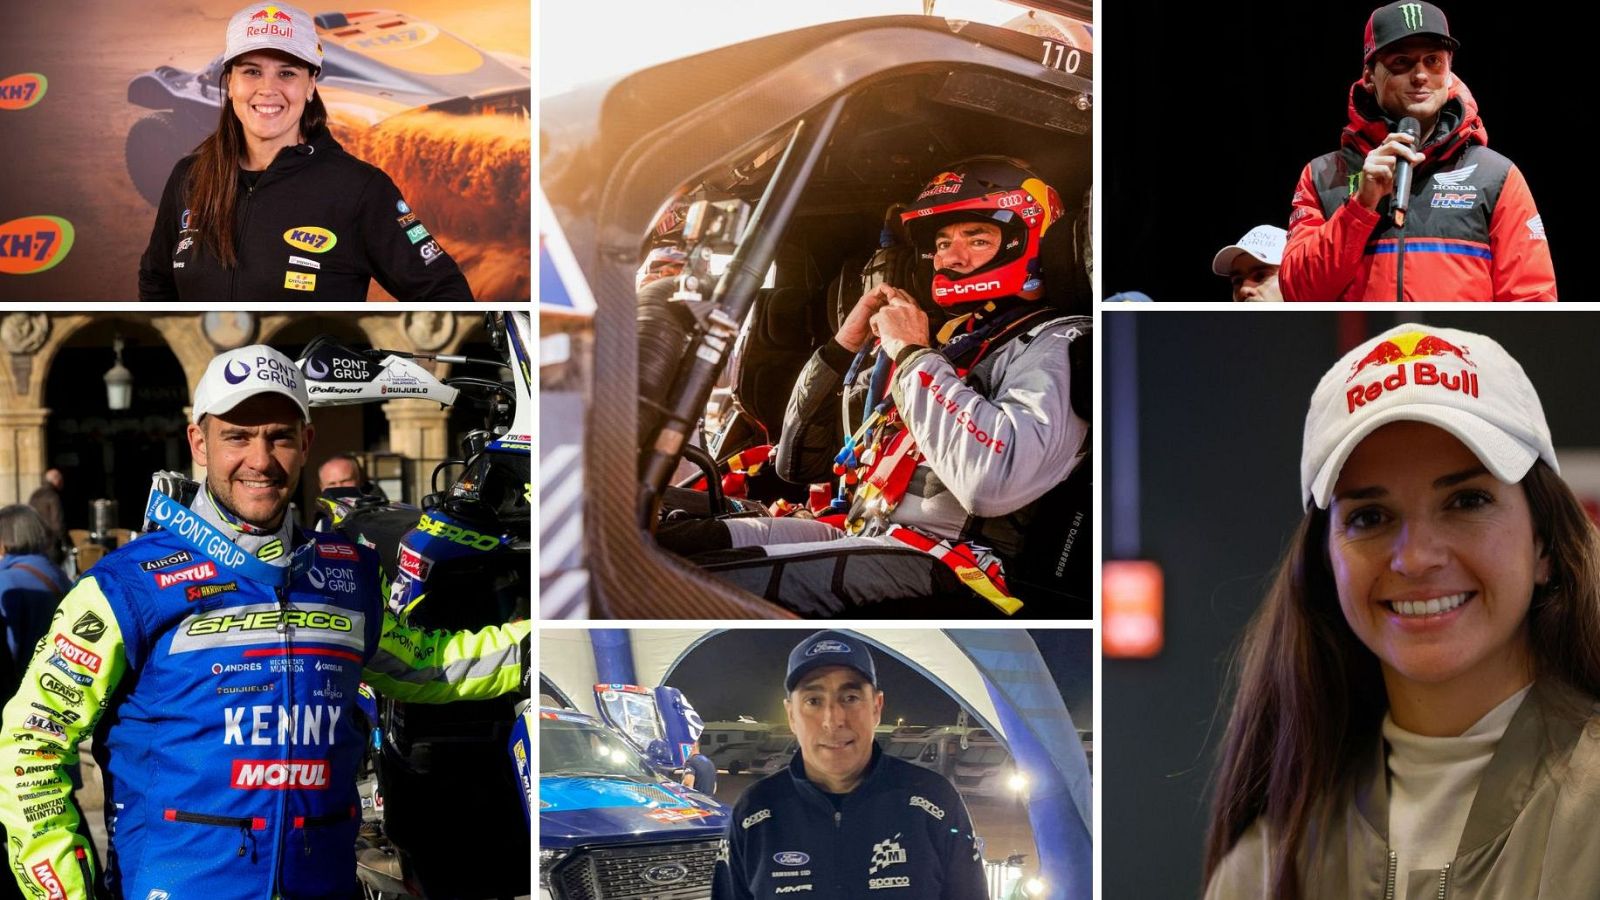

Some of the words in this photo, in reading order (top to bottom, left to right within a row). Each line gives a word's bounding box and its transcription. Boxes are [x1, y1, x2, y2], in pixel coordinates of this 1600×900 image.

[246, 23, 269, 37] Red
[270, 23, 293, 39] Bull
[1041, 41, 1081, 74] 110
[1430, 193, 1477, 205] HRC
[935, 280, 1001, 297] e-tron
[256, 356, 297, 380] PONT
[332, 357, 368, 372] PONT
[256, 369, 298, 391] GRUP
[333, 369, 371, 379] GRUP
[308, 385, 363, 395] Polisport
[387, 386, 429, 394] GUIJUELO
[1345, 363, 1407, 414] Red
[1414, 361, 1480, 399] Bull
[171, 509, 213, 546] PONT
[207, 536, 246, 569] GRUP
[415, 513, 500, 551] SHERCO
[318, 545, 354, 555] BS
[146, 552, 190, 570] AIROH
[159, 564, 215, 586] MOTUL
[325, 567, 354, 580] PONT
[328, 580, 357, 593] GRUP
[188, 610, 352, 636] SHERCO
[56, 637, 98, 669] MOTUL
[46, 679, 76, 701] AFAM
[223, 704, 341, 746] KENNY
[15, 776, 63, 789] SALAMANCA
[235, 763, 327, 786] MOTUL
[25, 805, 67, 823] MUNTADA
[908, 795, 945, 819] sparco
[780, 853, 804, 864] Ford
[868, 876, 909, 887] sparco
